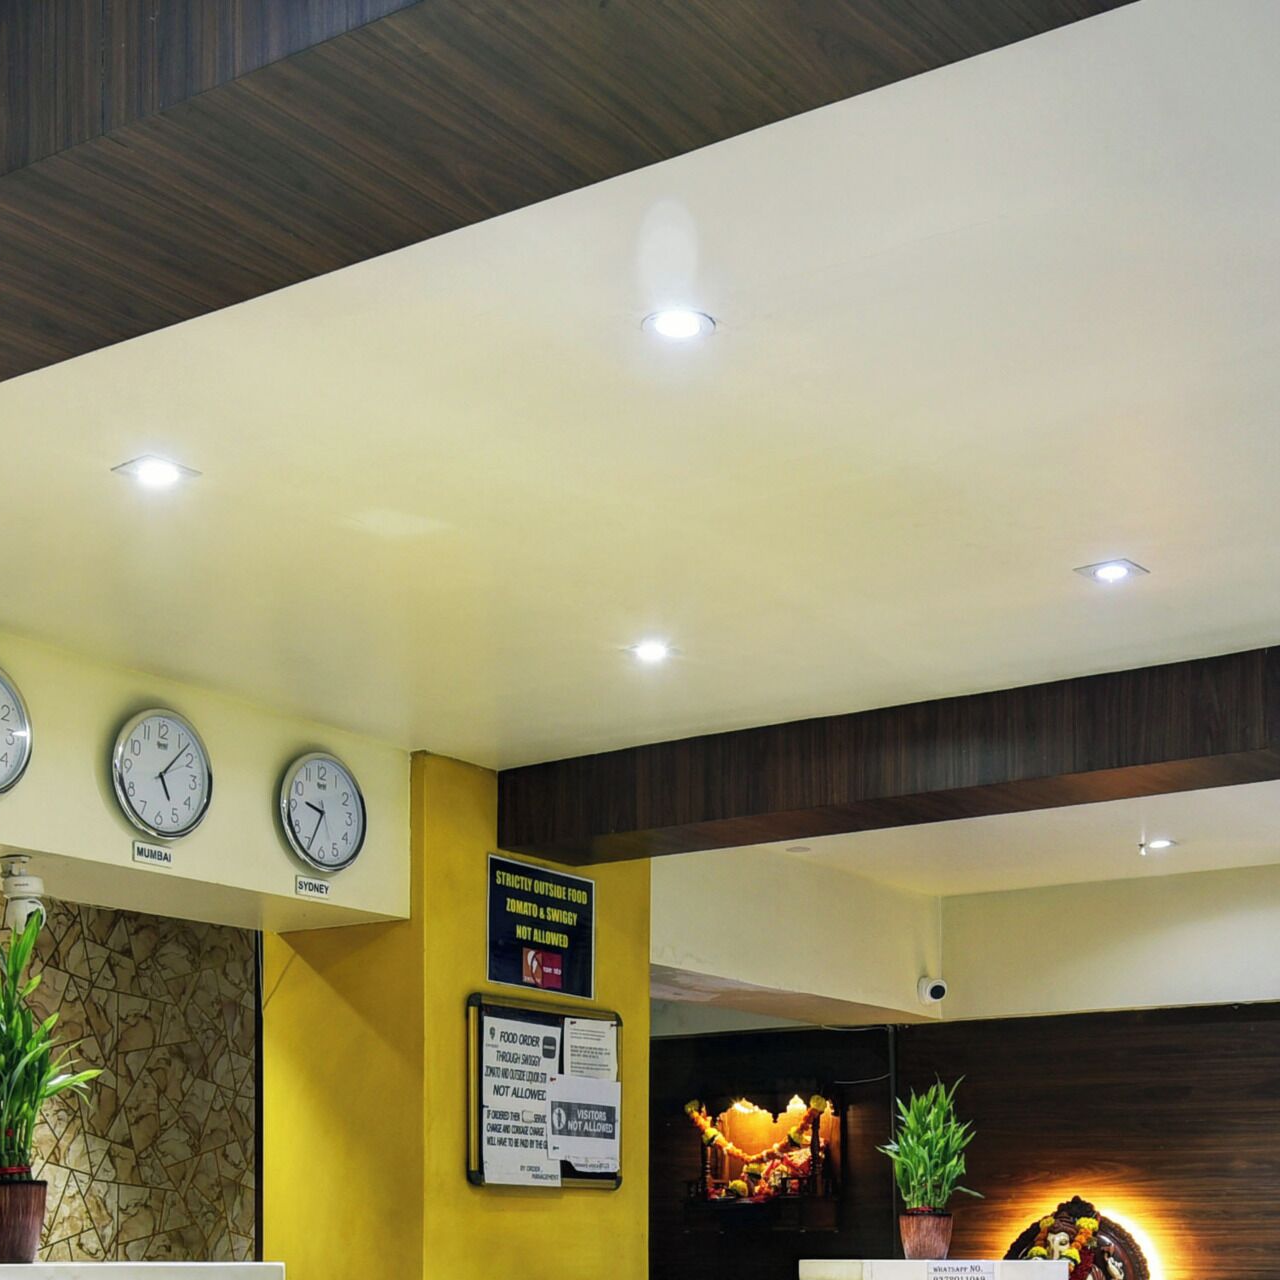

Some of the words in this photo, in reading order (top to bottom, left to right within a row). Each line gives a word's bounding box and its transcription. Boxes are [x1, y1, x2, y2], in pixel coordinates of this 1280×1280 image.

[1, 704, 11, 722] 2
[5, 728, 15, 745] 3
[144, 725, 150, 740] 11
[158, 723, 169, 740] 12
[131, 738, 141, 756] 10
[0, 752, 8, 767] 4
[124, 758, 132, 773] 9
[185, 753, 193, 768] 2
[306, 768, 311, 782] 11
[318, 765, 326, 780] 12
[128, 782, 135, 797] 8
[189, 775, 197, 790] 3
[295, 780, 304, 796] 10
[184, 796, 191, 811] 4
[290, 799, 297, 812] 9
[342, 792, 349, 806] 2
[140, 800, 147, 815] 7
[154, 811, 162, 825] 6
[171, 808, 179, 823] 5
[345, 812, 352, 826] 3
[295, 820, 301, 834] 8
[342, 832, 348, 845] 4
[137, 847, 171, 863] MUMBAI
[318, 846, 325, 859] 6
[332, 843, 339, 857] 5
[298, 881, 329, 894] SYDNEY
[496, 870, 533, 892] STRICTLY
[534, 881, 566, 900] OUTSIDE
[568, 888, 587, 905] FOOD
[506, 897, 538, 918] ZOMATO
[540, 907, 545, 919] &
[546, 907, 577, 926] SWIGGY
[516, 924, 532, 941] NOT
[533, 928, 568, 948] ALLOWED
[500, 1031, 518, 1044] FOOD
[519, 1034, 540, 1047] ORDER
[496, 1050, 520, 1064] THROUGH
[521, 1054, 541, 1066] SWIGGY
[493, 1084, 510, 1096] NOT
[577, 1109, 606, 1120] VISITORS
[568, 1119, 582, 1131] NOT
[583, 1121, 613, 1133] ALLOWED
